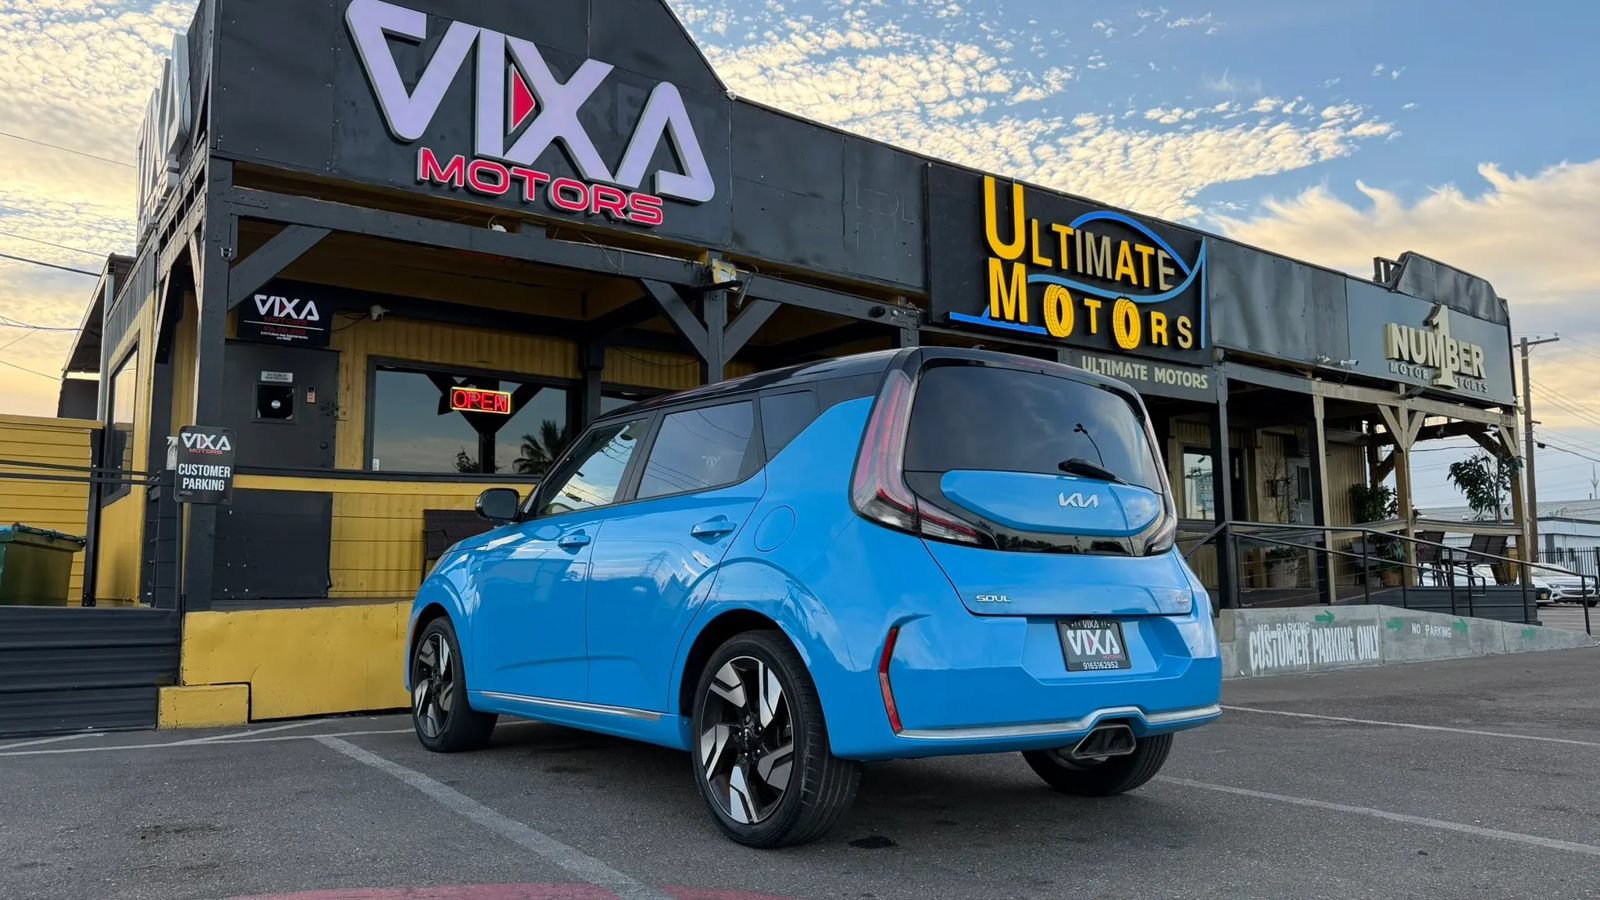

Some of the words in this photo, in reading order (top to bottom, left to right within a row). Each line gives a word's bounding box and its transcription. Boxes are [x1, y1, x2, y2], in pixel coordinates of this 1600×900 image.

[345, 0, 715, 203] VIXA
[418, 147, 664, 226] MOTORS
[984, 175, 1176, 291] ULTIMATE
[253, 294, 320, 321] VIXA
[988, 256, 1194, 350] MOTORS
[1385, 322, 1487, 379] NUMBER
[1082, 355, 1148, 381] ULTIMATE
[1154, 366, 1209, 390] MOTORS
[1389, 361, 1430, 380] MOTOR
[453, 390, 507, 412] OPEN
[181, 432, 232, 451] VIXA
[178, 463, 231, 478] CUSTOMER
[182, 477, 225, 491] PARKING
[1058, 492, 1099, 508] KIA
[976, 594, 1011, 603] SOUL
[1066, 629, 1120, 656] VIXA
[1411, 622, 1421, 634] NO
[1425, 624, 1452, 639] PARKING
[1249, 630, 1310, 670] CUSTOMER
[1311, 626, 1355, 664] PARKING
[1356, 625, 1380, 660] ONLY
